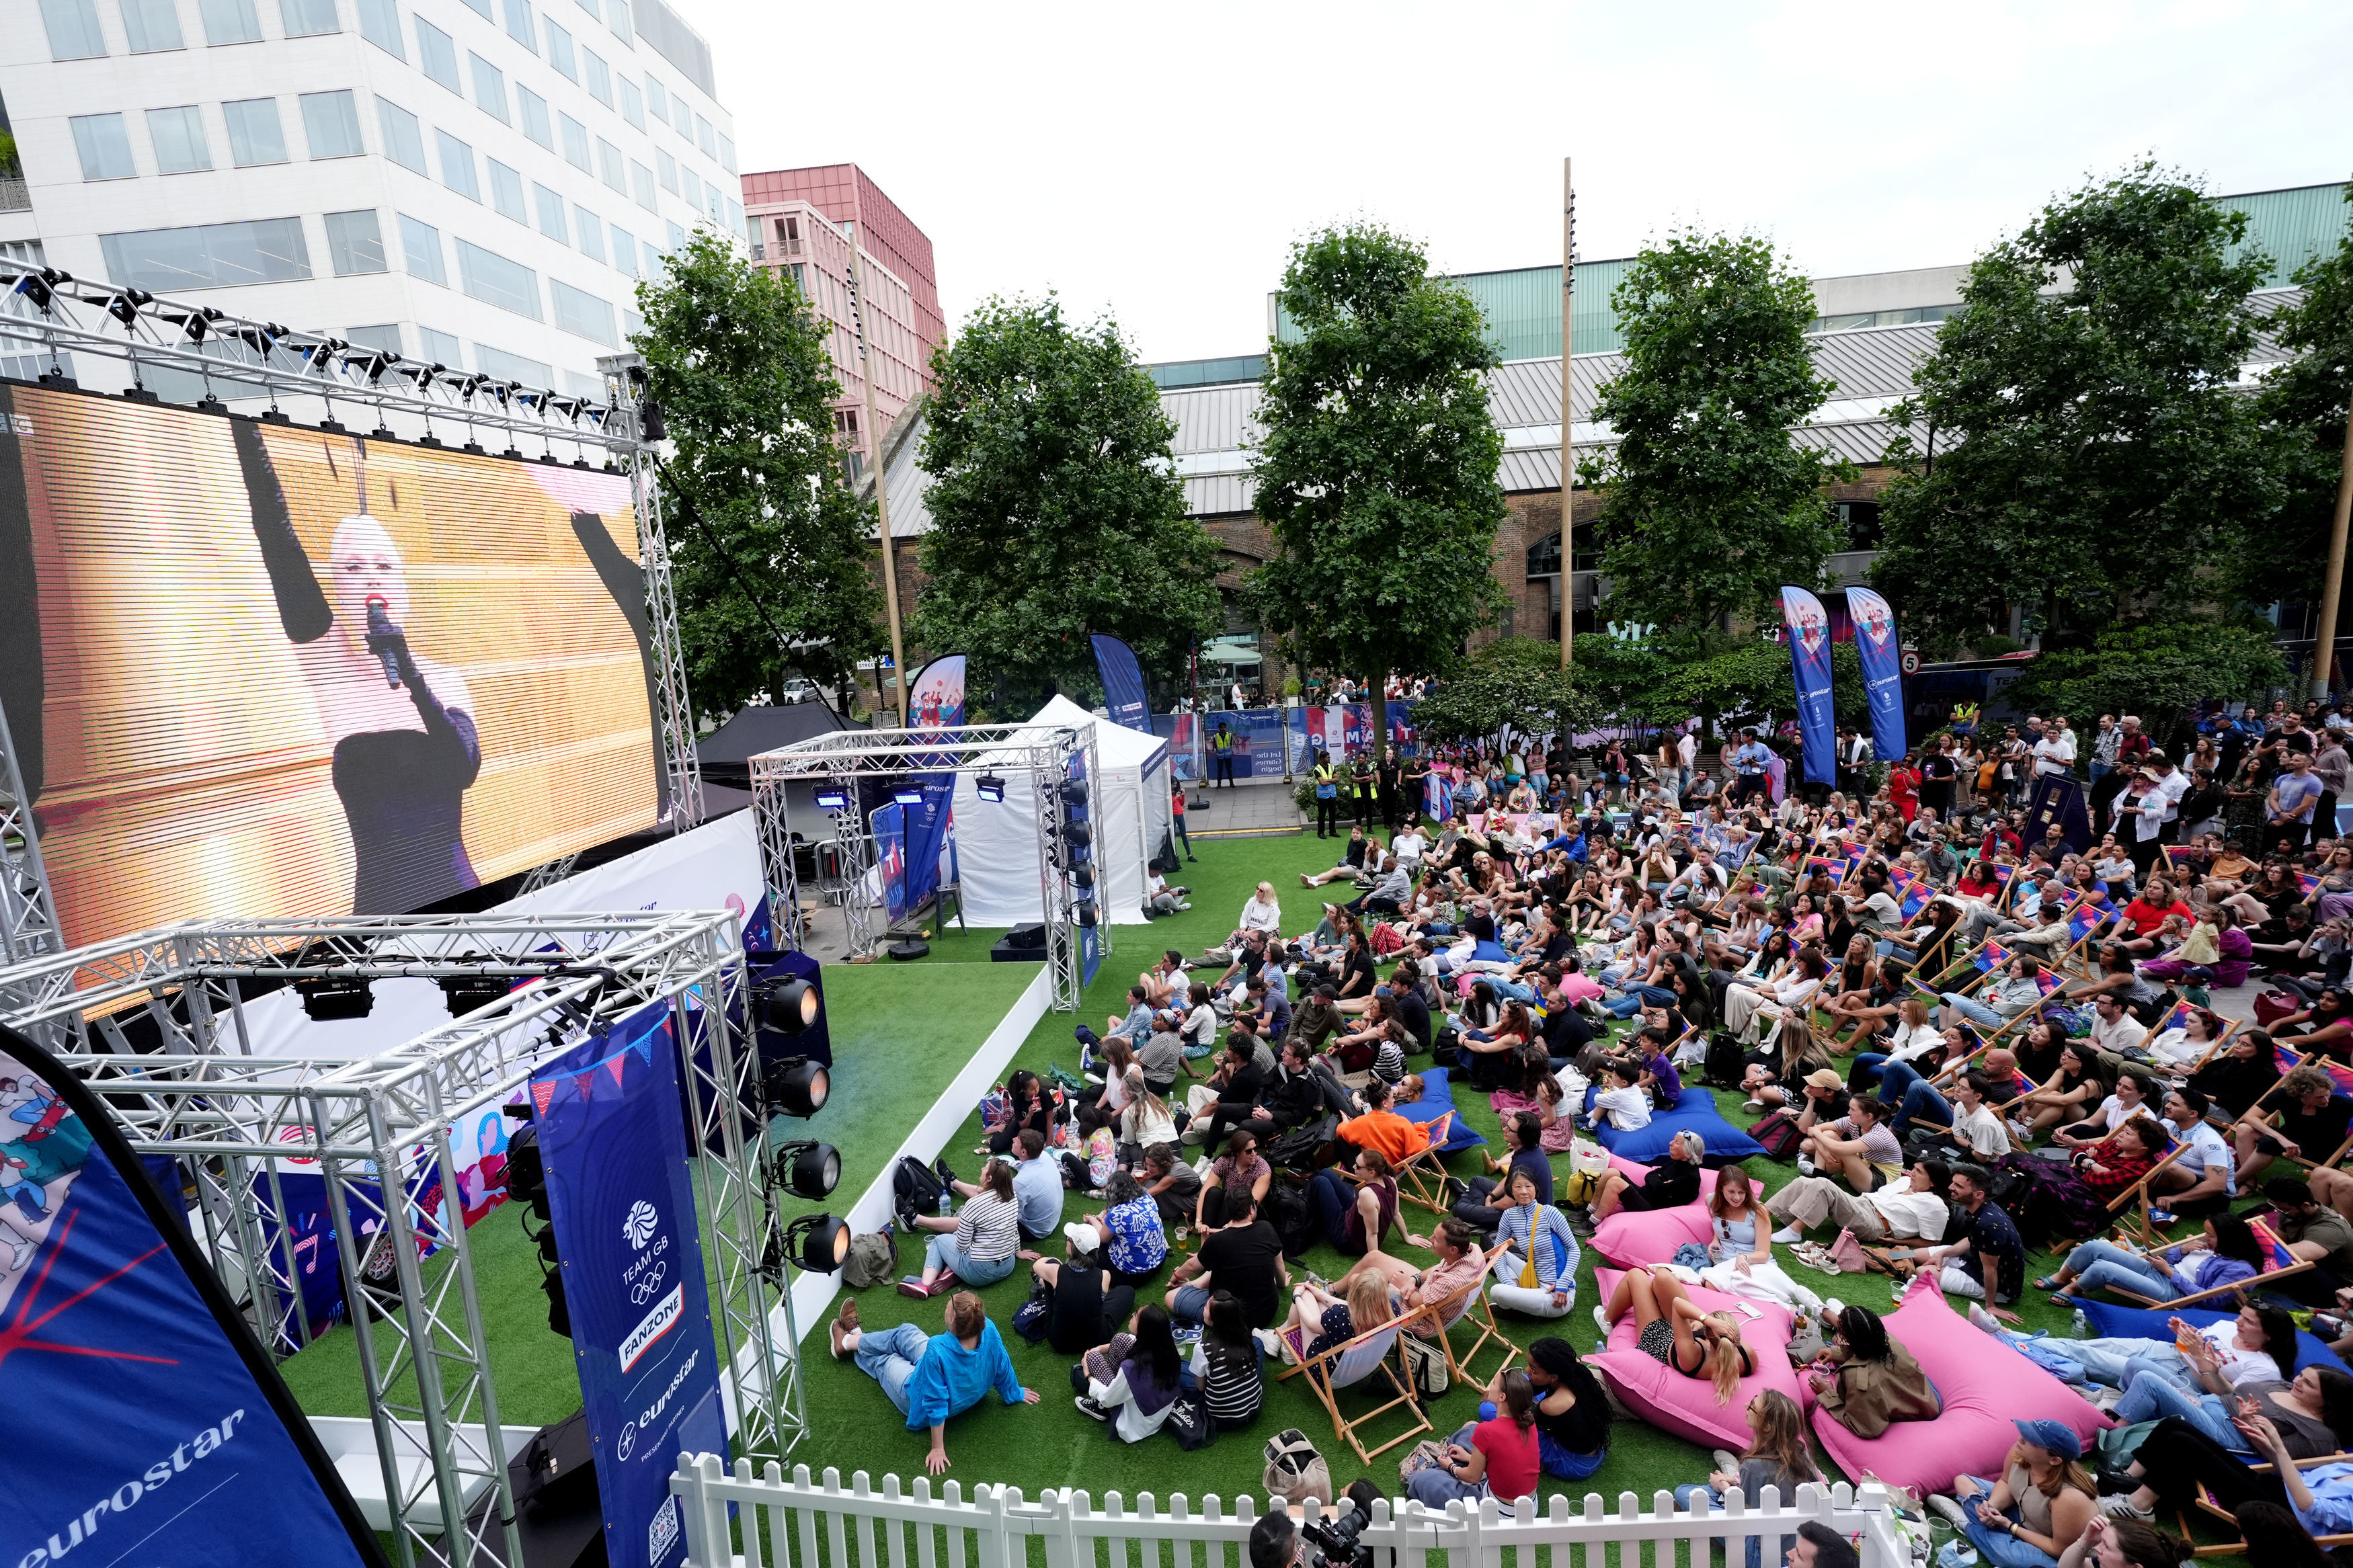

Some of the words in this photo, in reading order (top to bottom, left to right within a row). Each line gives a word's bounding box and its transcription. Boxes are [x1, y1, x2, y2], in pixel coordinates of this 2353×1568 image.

[1876, 674, 1899, 686] eurostar
[1906, 657, 1915, 670] 5
[1994, 677, 2019, 686] TEA
[623, 1250, 651, 1285] TEAM
[653, 1235, 668, 1255] GB
[625, 1295, 679, 1360] FANZONE
[639, 1349, 699, 1429] eurostar
[641, 1427, 668, 1463] PRESENTING
[668, 1405, 685, 1430] PARTNER
[1171, 1405, 1195, 1428] ollister
[19, 1409, 245, 1568] eurostar
